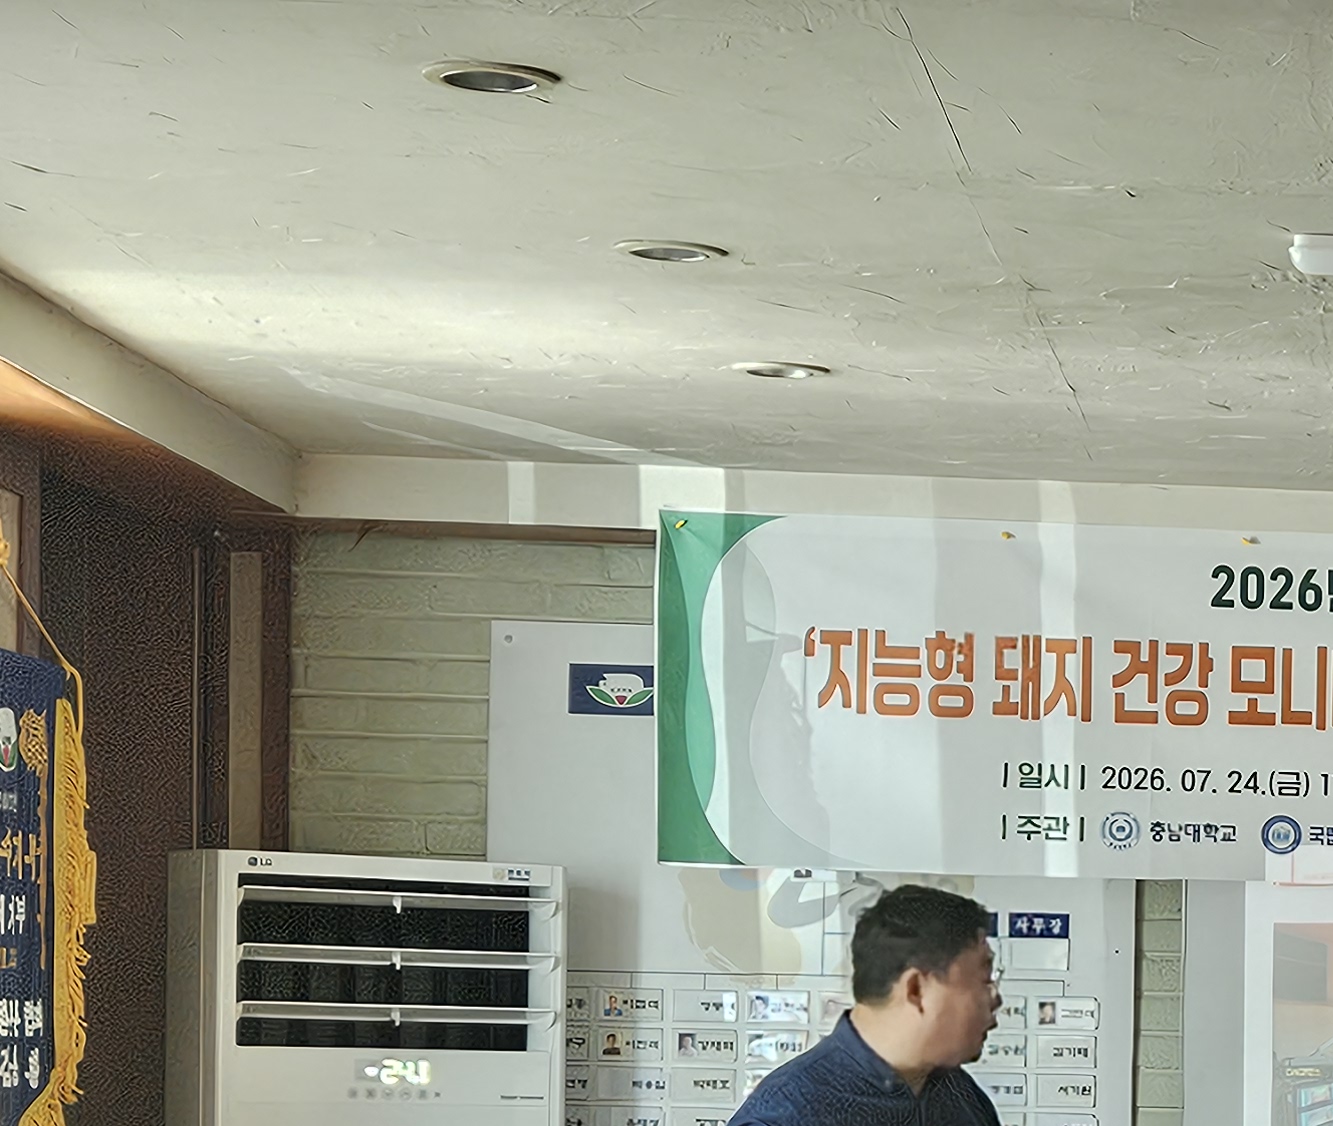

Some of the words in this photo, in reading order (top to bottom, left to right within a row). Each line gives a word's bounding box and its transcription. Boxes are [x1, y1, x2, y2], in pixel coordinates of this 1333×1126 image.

[992, 634, 1092, 722] 돼지
[1112, 639, 1213, 726] 건강
[1018, 763, 1069, 789] 일시
[1102, 766, 1171, 791] 2026.
[1181, 769, 1217, 793] 07.
[1228, 771, 1309, 797] 24.(금)
[1017, 816, 1069, 841] 주관
[1150, 821, 1236, 843] 충남대학교
